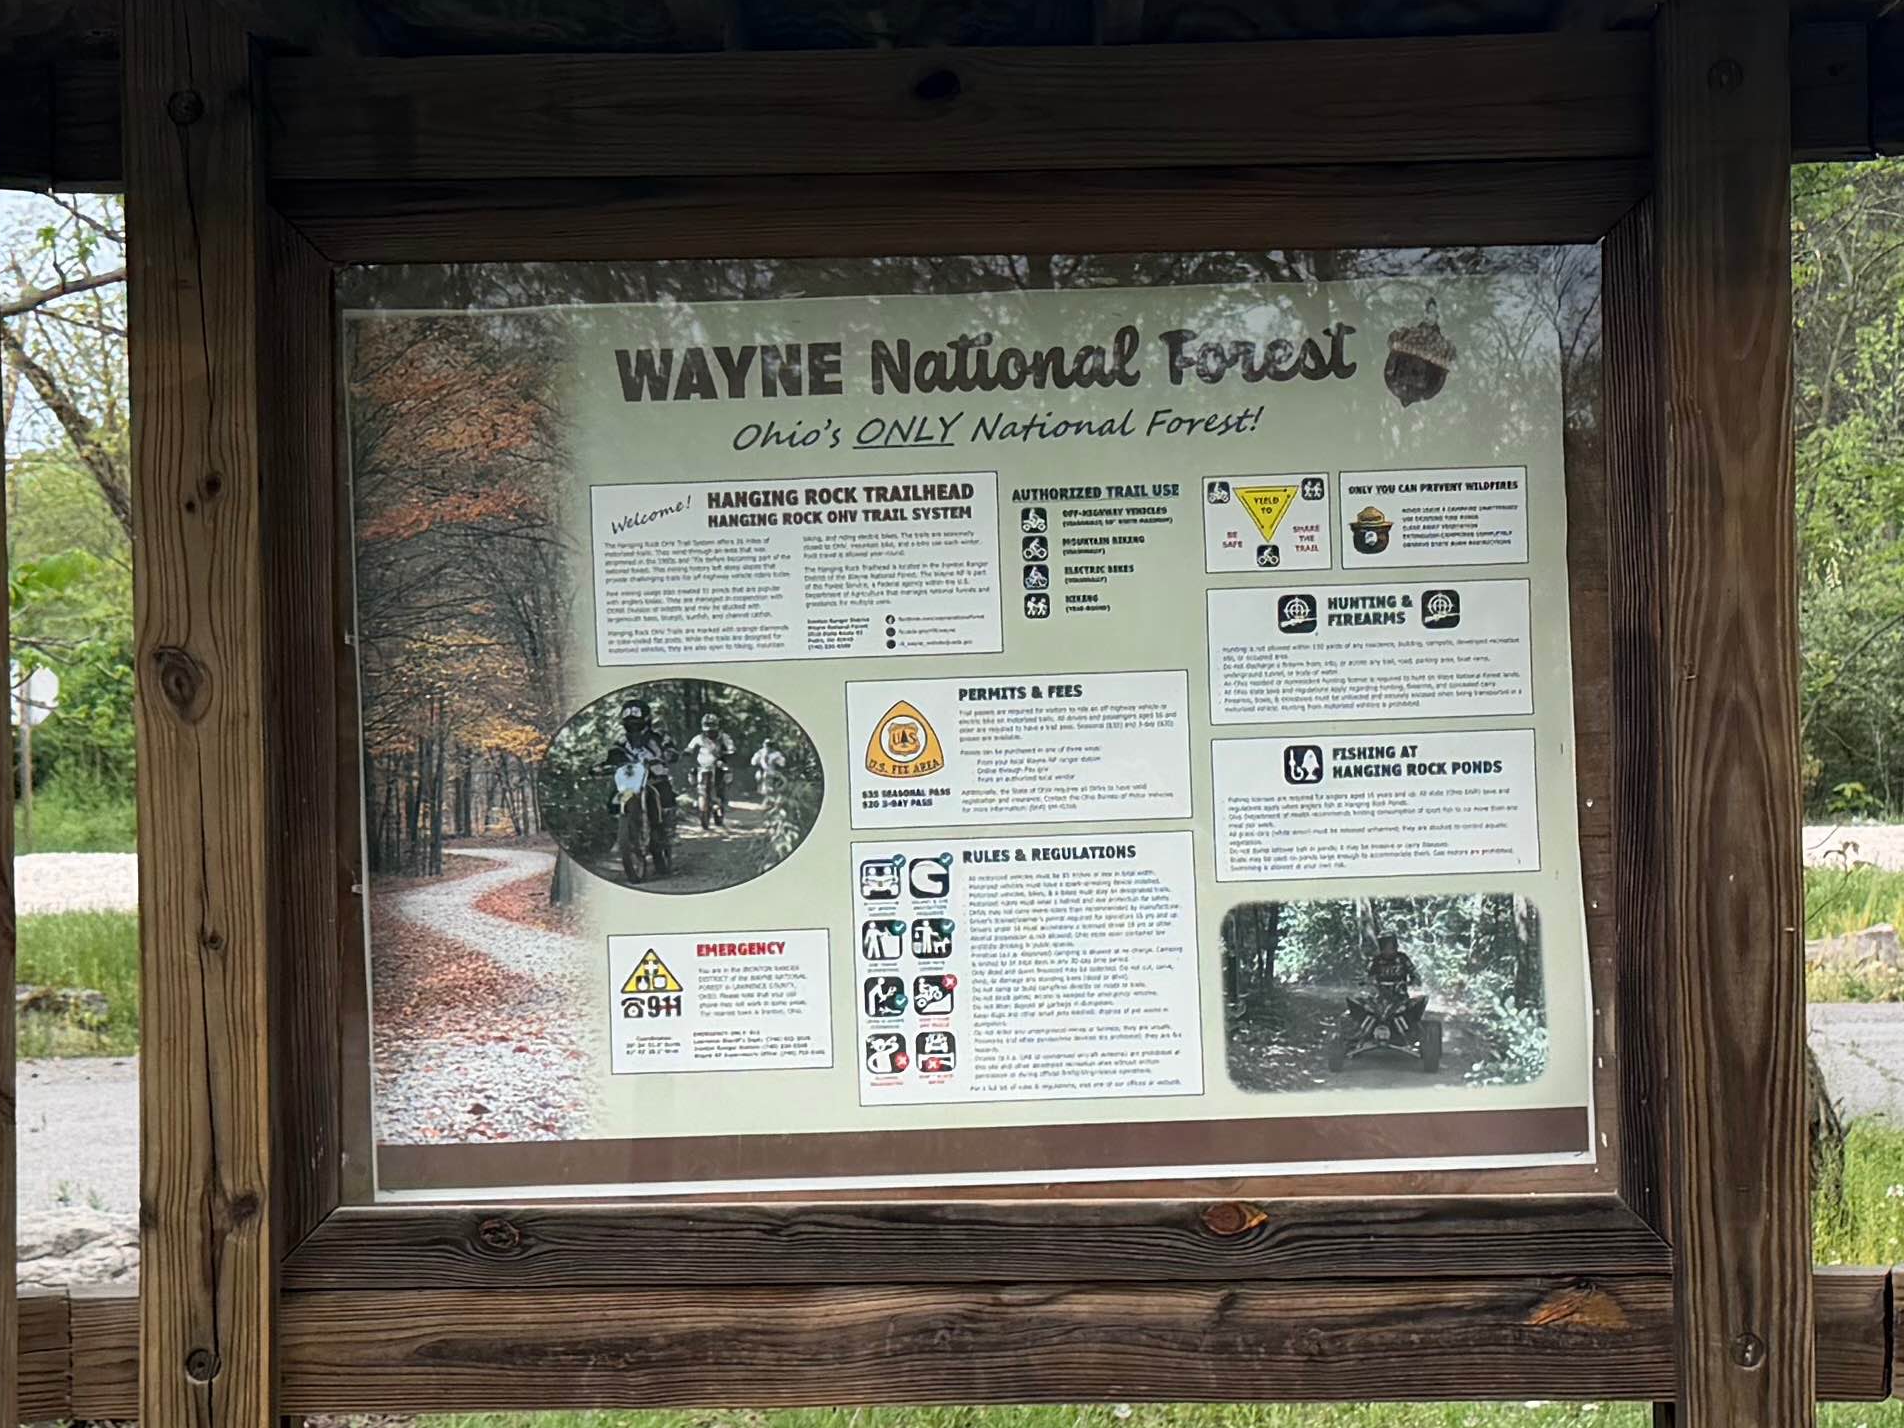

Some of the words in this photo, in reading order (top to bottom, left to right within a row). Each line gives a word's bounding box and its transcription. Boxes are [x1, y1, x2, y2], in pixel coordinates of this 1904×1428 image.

[615, 342, 844, 402] WAYNE
[872, 328, 1140, 397] National
[1160, 322, 1358, 386] Forest
[733, 415, 842, 452] Ohio's
[853, 410, 962, 448] ONLY
[973, 409, 1135, 443] National
[1147, 405, 1264, 436] Forest!
[707, 488, 799, 510] HANGING
[804, 486, 858, 506] ROCK
[863, 483, 975, 505] TRAILHEAD
[1012, 486, 1102, 503] AUTHORIZED
[1104, 484, 1148, 500] TRAIL
[1152, 484, 1180, 498] USE
[1349, 485, 1372, 496] ONLY
[1373, 484, 1396, 494] YOU
[1398, 484, 1418, 494] CAN
[1420, 482, 1463, 492] PREVENT
[1253, 496, 1280, 506] YIELD
[611, 494, 692, 535] Welcome!
[708, 512, 778, 528] HANGING
[782, 510, 824, 526] ROCK
[827, 509, 858, 525] OHV
[862, 508, 908, 524] TRAIL
[912, 505, 972, 521] SYSTEM
[1260, 506, 1273, 515] TO
[1294, 543, 1320, 553] TRAIL
[1328, 596, 1398, 610] HUNTING
[1402, 595, 1413, 608] &
[1328, 612, 1406, 627] FIREARMS
[958, 686, 1027, 702] PERMITS
[1032, 685, 1044, 699] &
[1048, 684, 1083, 698] FEES
[1332, 746, 1396, 761] FISHING
[1399, 744, 1418, 758] AT
[868, 759, 888, 774] U.S.
[1332, 764, 1402, 779] HANGING
[1406, 762, 1446, 776] ROCK
[1451, 760, 1503, 776] PONDS
[882, 788, 926, 799] SEASONAL
[928, 787, 952, 796] PASS
[910, 798, 933, 808] PASS
[962, 848, 1011, 864] RULES
[1014, 848, 1028, 862] &
[1031, 845, 1136, 862] REGULATIONS
[696, 941, 786, 958] EMERGENCY
[648, 995, 682, 1018] 911
